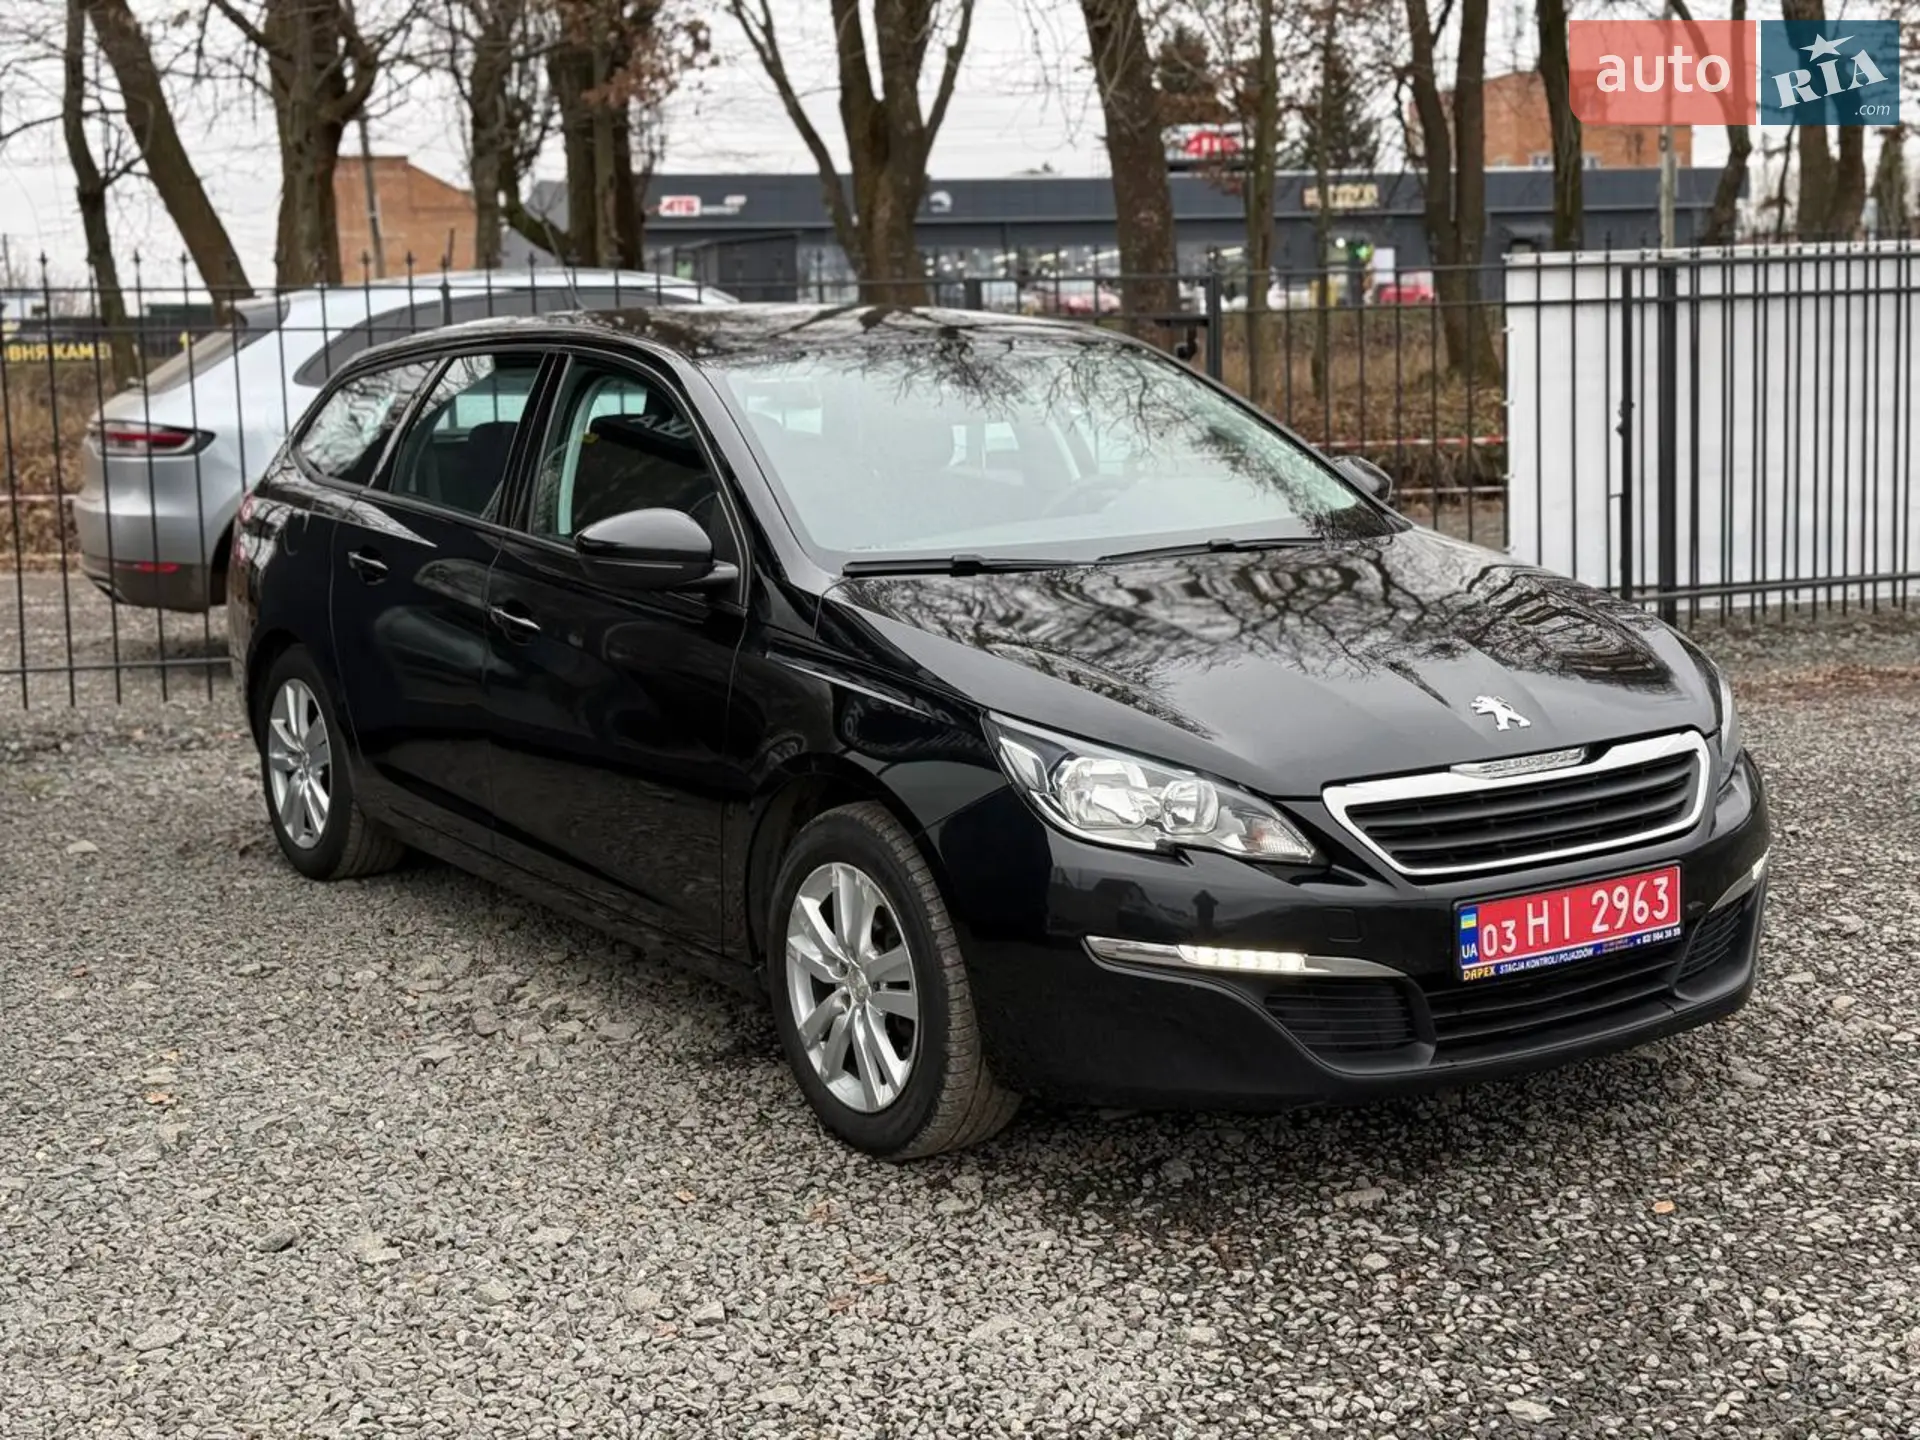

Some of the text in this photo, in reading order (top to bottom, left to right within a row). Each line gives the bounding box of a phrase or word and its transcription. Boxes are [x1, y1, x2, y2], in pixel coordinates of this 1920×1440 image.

[1482, 919, 1517, 957] 03
[1591, 876, 1669, 934] 2963
[1461, 942, 1479, 959] UA
